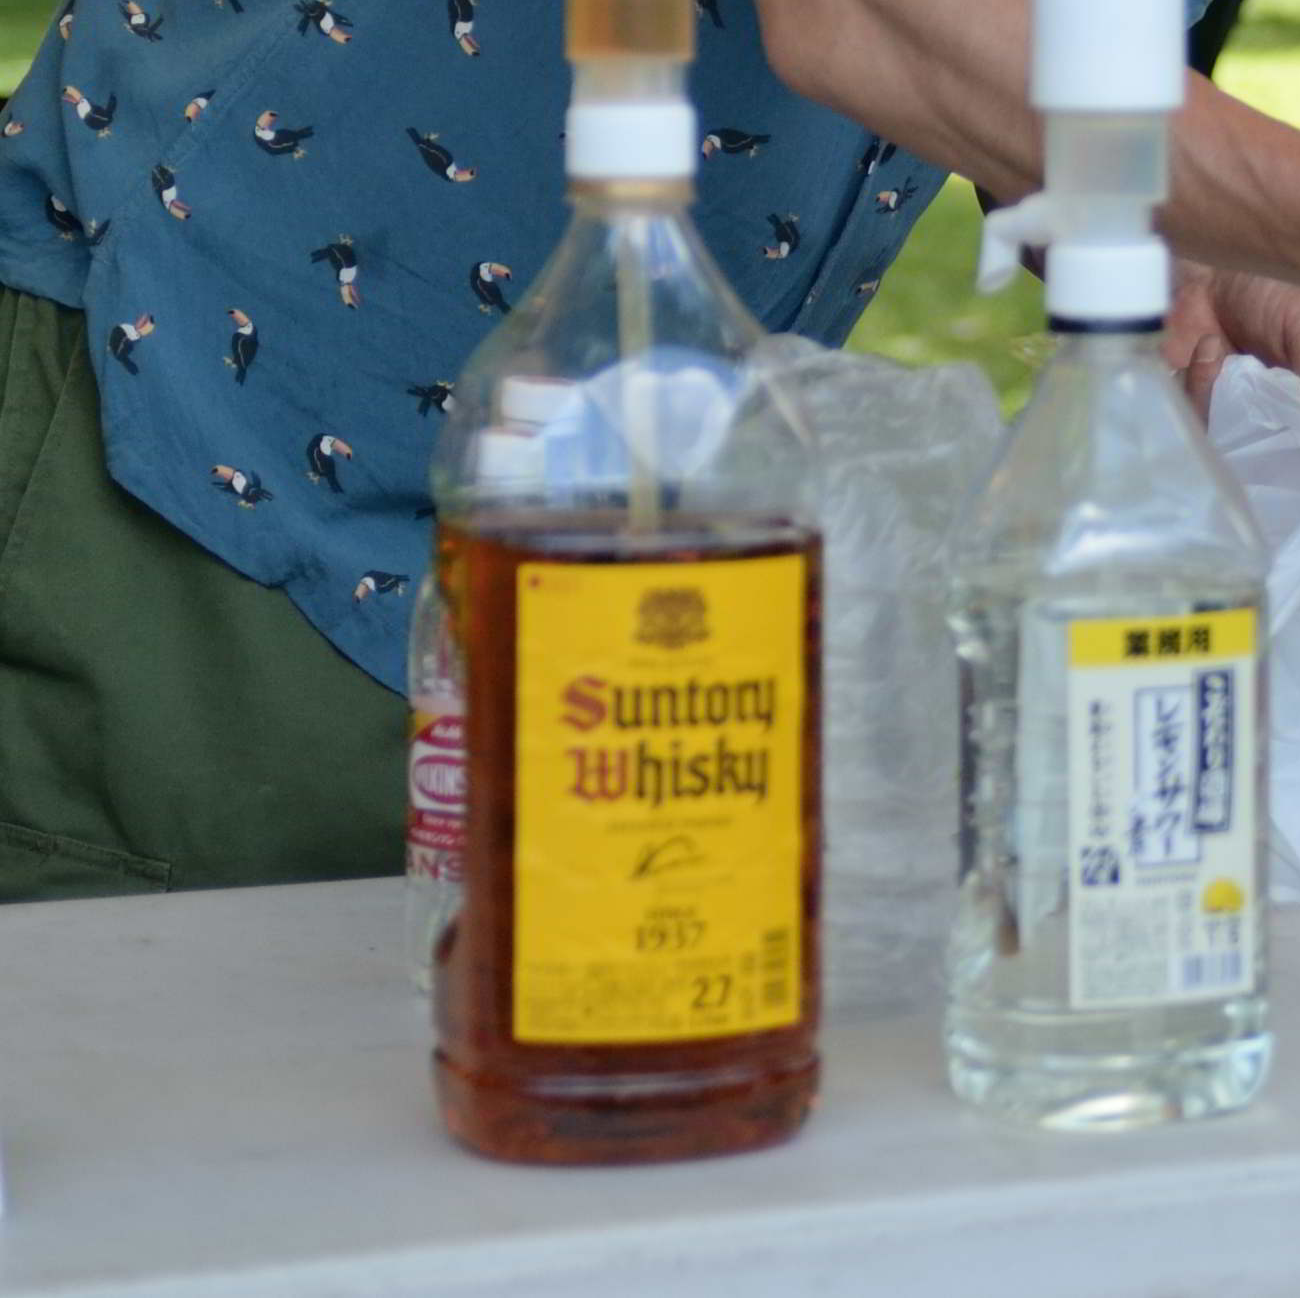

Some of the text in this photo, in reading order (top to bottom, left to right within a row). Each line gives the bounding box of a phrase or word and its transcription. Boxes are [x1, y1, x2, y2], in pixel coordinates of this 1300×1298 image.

[1121, 626, 1212, 657] 業務用
[557, 674, 776, 732] Suntory
[564, 736, 769, 807] Whisky
[1153, 698, 1187, 857] レモンサワー
[634, 920, 707, 950] 1937
